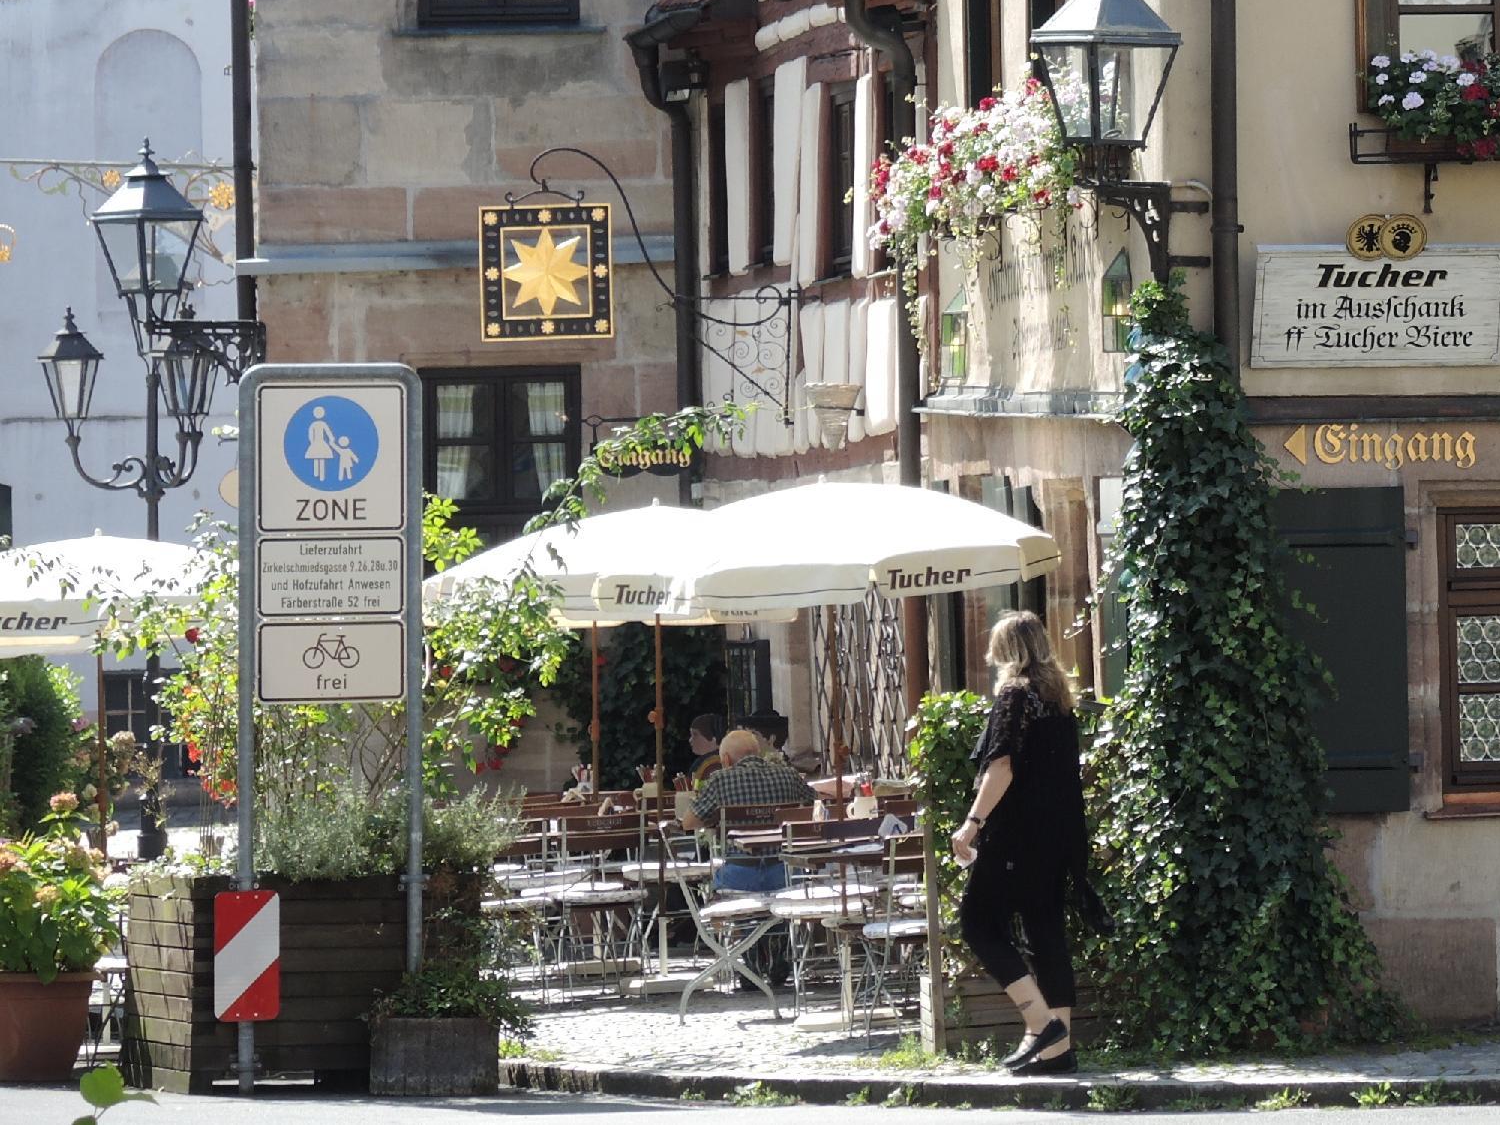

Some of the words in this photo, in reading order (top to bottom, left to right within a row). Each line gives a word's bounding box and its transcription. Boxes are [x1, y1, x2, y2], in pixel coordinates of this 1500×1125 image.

[1316, 263, 1449, 288] Tucher
[1296, 298, 1327, 320] im
[1312, 323, 1399, 354] Tucher
[1403, 324, 1474, 349] Biere
[1314, 423, 1477, 471] Eingang
[296, 498, 367, 521] ZONE
[300, 544, 362, 555] Lieferzufahrt
[262, 562, 347, 574] Zirkelschmiedsgasse
[887, 566, 971, 590] Tucher
[271, 580, 288, 591] und
[292, 579, 344, 590] Hofzufahrt
[348, 578, 391, 590] Anwesen
[615, 584, 671, 605] Tucher
[281, 597, 343, 609] Färberstraße
[348, 596, 359, 607] 52
[364, 596, 380, 607] frei
[0, 611, 68, 630] cher
[317, 674, 348, 690] frei
